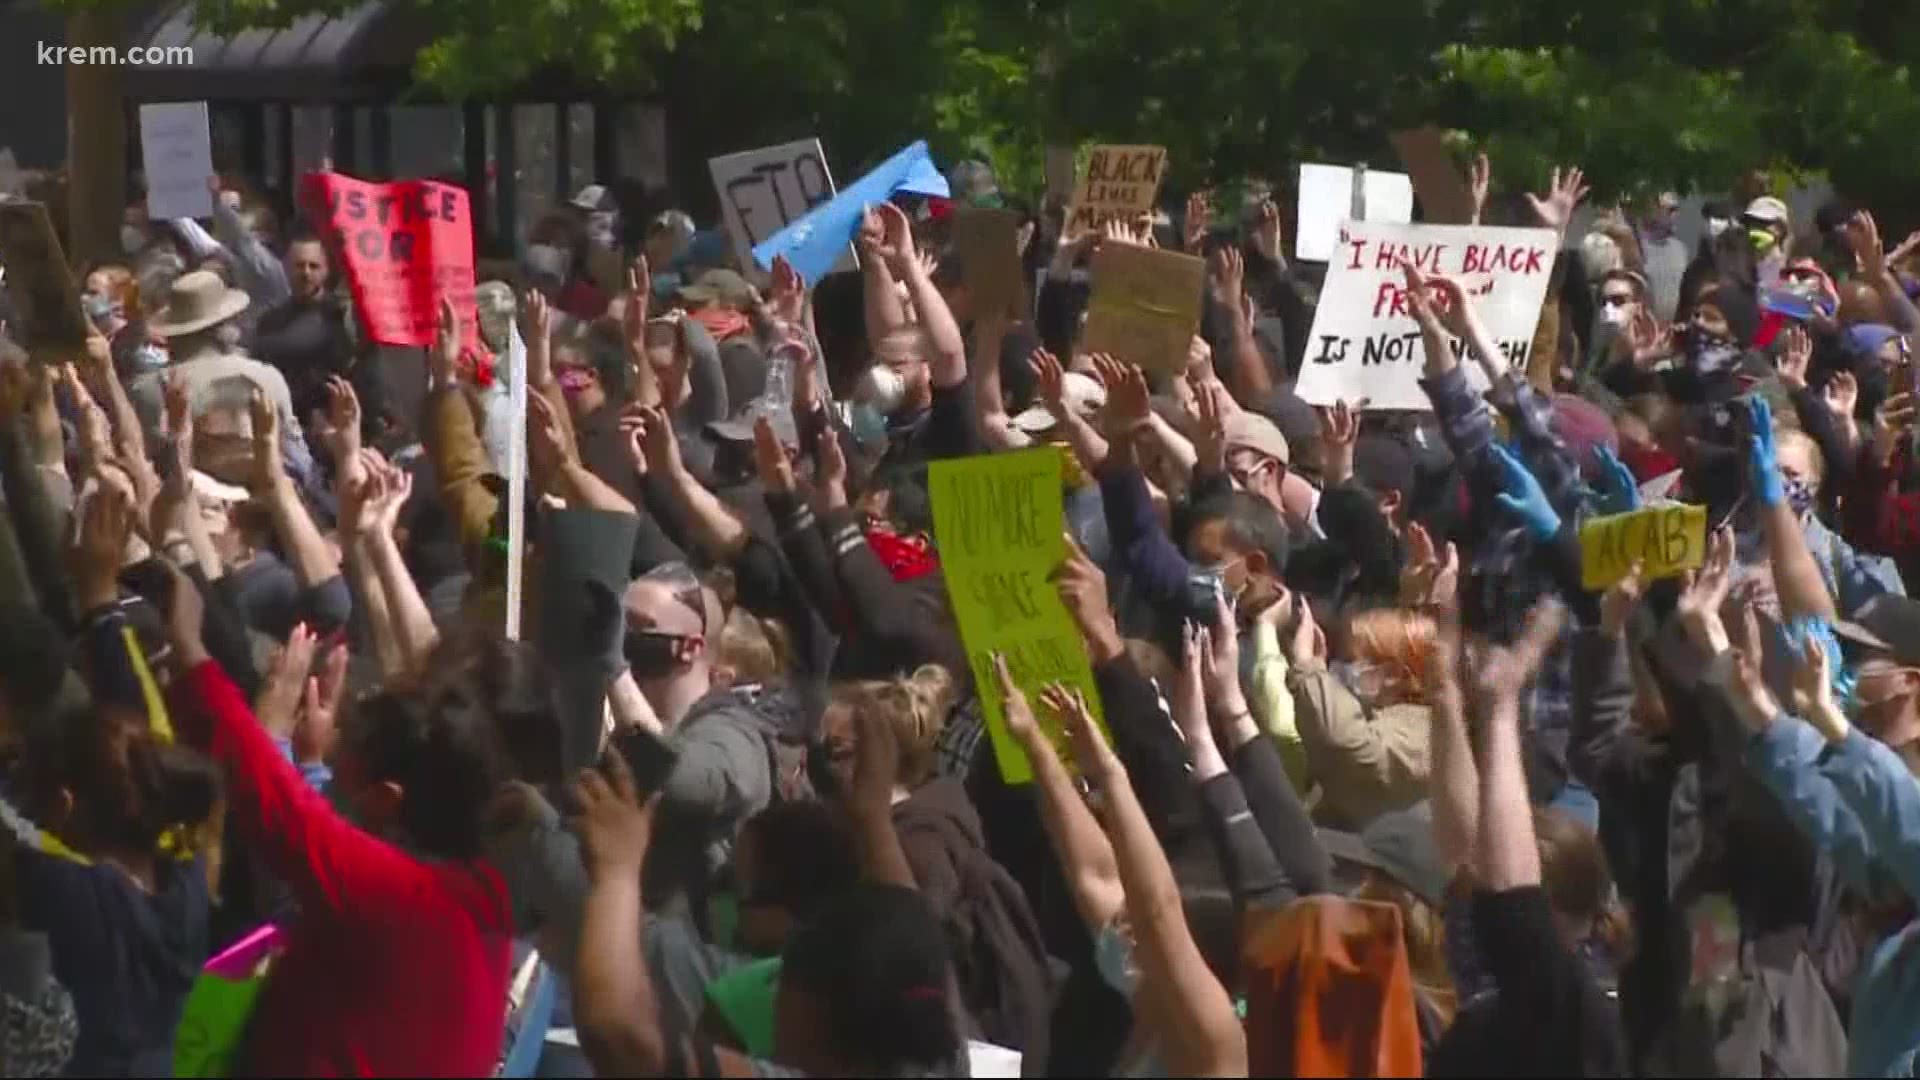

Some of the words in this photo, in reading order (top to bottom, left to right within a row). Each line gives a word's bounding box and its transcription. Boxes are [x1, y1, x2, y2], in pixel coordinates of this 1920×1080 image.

[1087, 151, 1163, 184] BLACK
[1375, 241, 1448, 275] HAVE
[1461, 243, 1544, 275] BLACK
[1362, 332, 1421, 366] NOT
